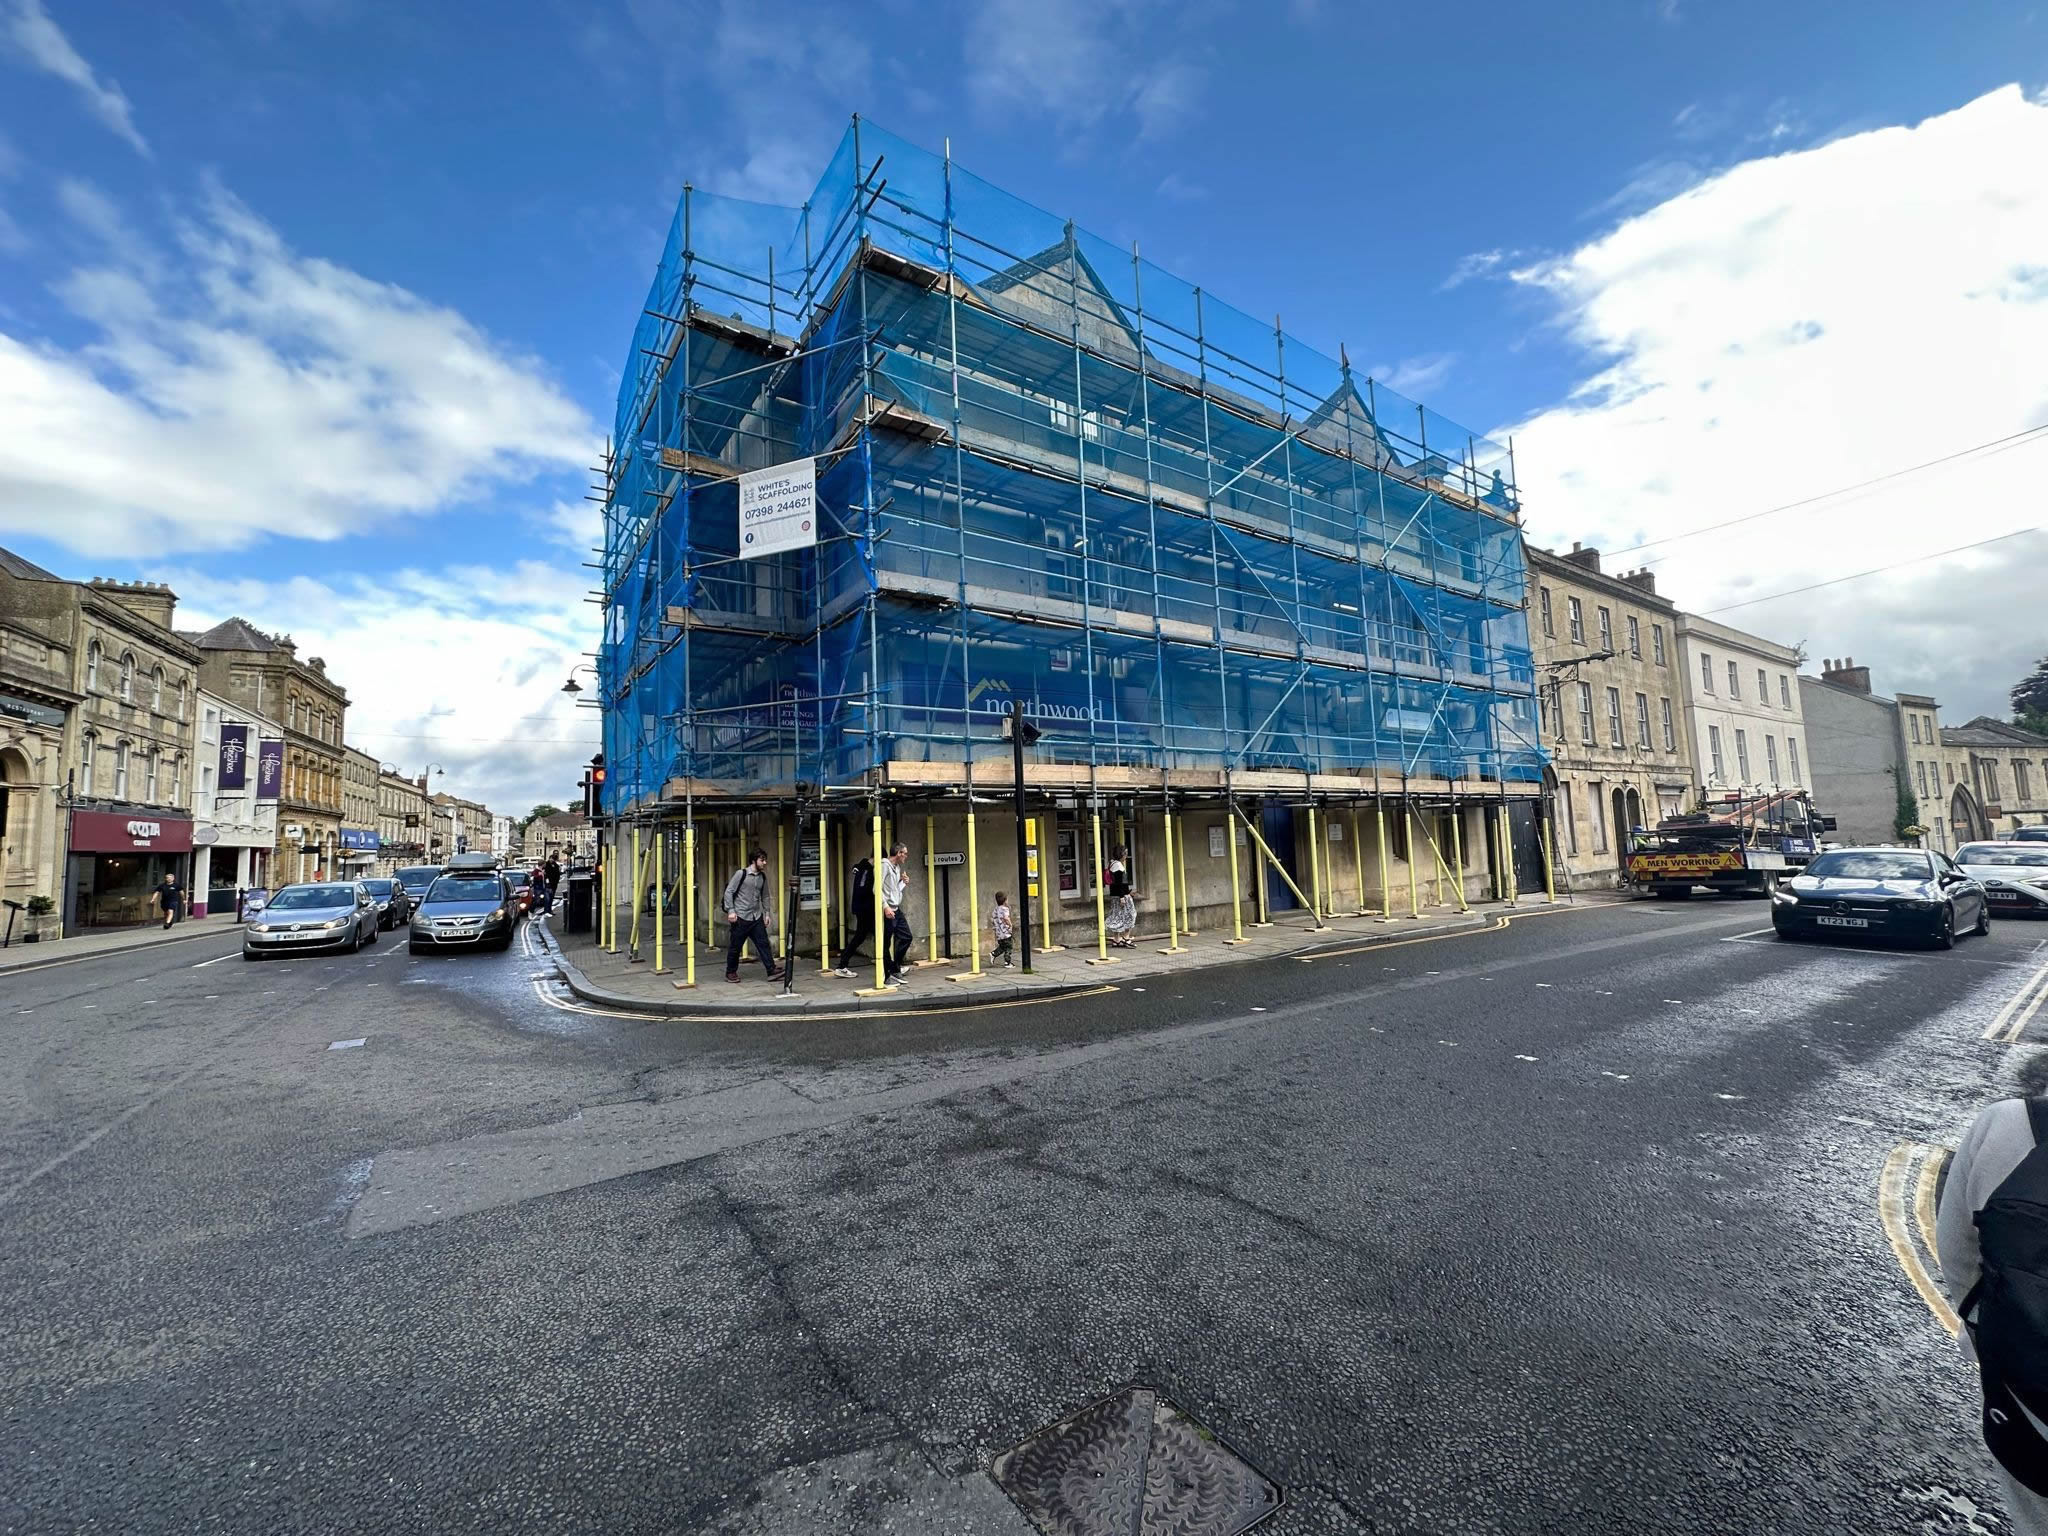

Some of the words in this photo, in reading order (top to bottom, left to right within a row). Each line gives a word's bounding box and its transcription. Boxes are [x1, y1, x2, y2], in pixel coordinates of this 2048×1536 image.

[758, 479, 790, 493] WHITE'S
[758, 482, 813, 502] SCAFFOLDING
[745, 506, 773, 520] 07398
[777, 497, 811, 513] 244621
[937, 855, 958, 863] routes
[1671, 858, 1720, 867] WORKING
[1820, 916, 1843, 925] KT23
